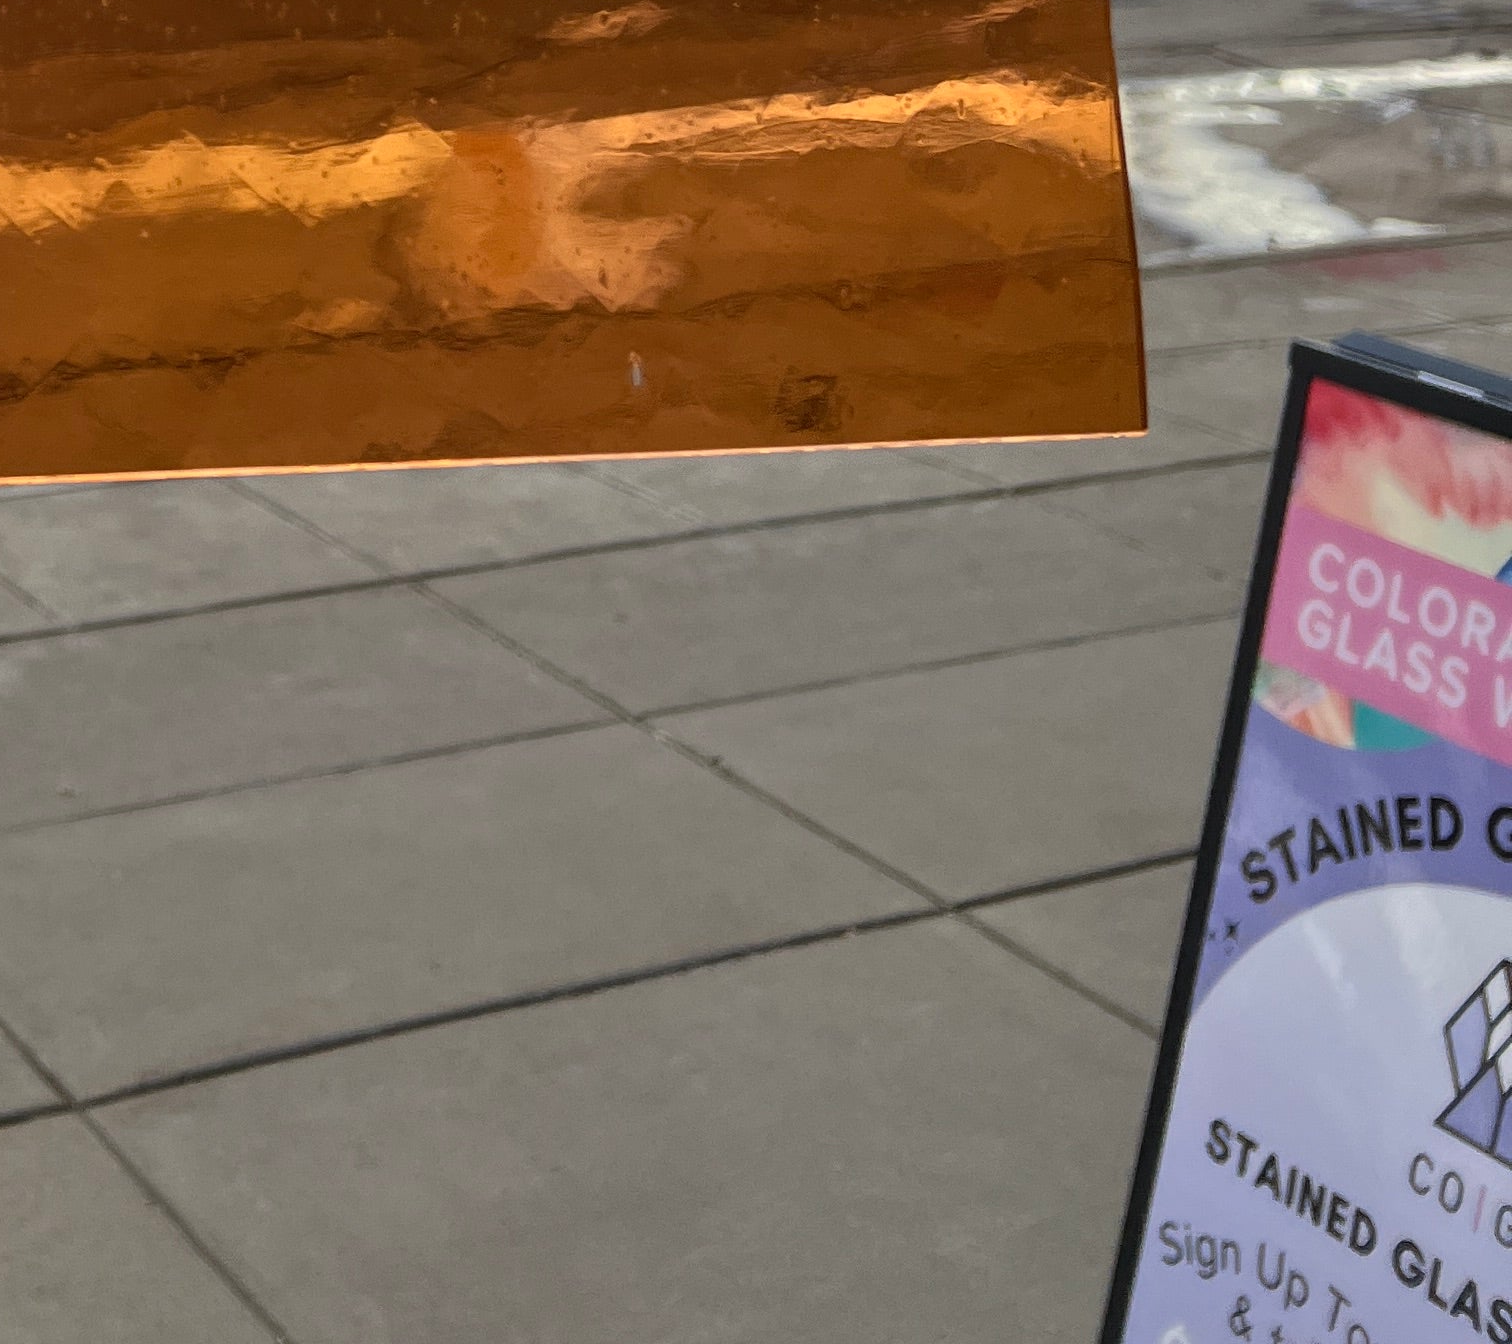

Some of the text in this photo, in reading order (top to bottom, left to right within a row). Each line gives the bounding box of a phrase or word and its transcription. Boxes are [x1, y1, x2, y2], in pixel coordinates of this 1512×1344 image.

[1298, 599, 1469, 709] GLASS
[1242, 794, 1464, 904] STAINED
[1206, 1118, 1378, 1257] STAINED
[1158, 1220, 1242, 1280] Sign
[1257, 1242, 1310, 1311] Up
